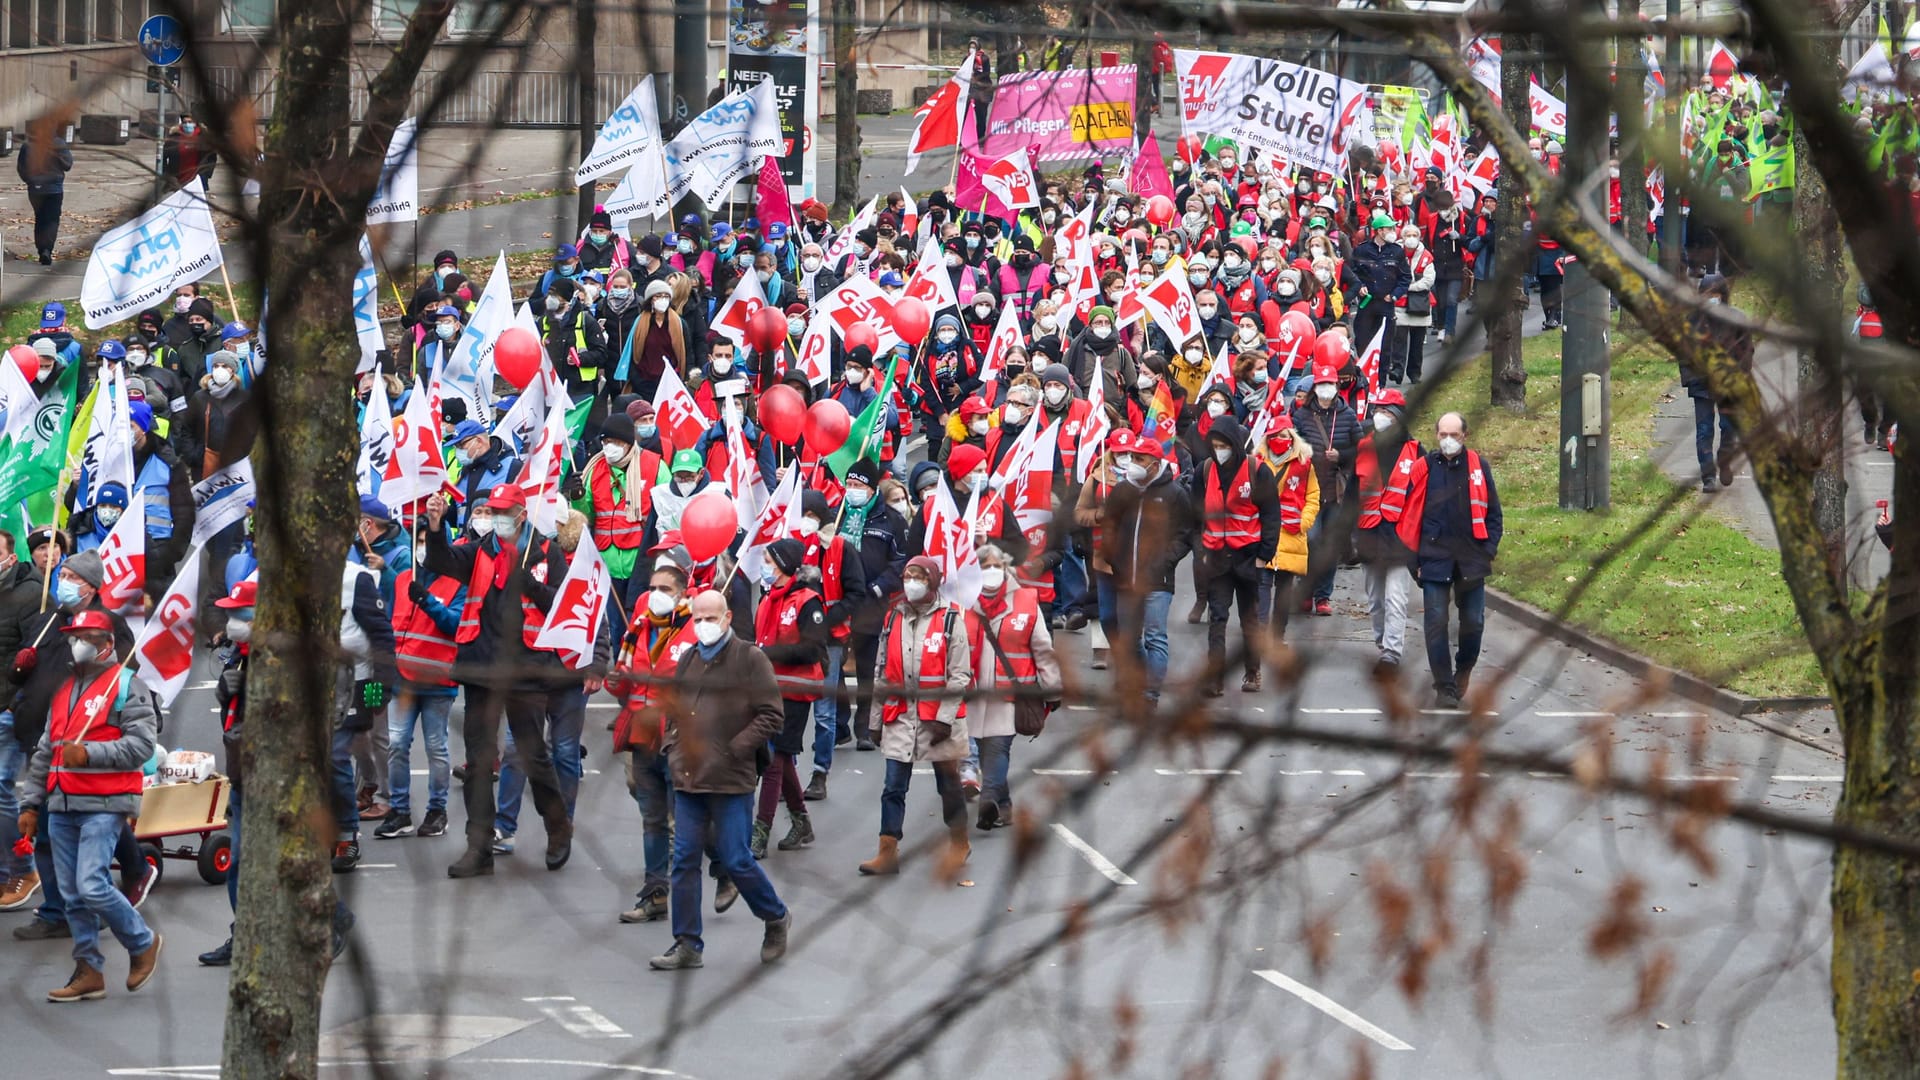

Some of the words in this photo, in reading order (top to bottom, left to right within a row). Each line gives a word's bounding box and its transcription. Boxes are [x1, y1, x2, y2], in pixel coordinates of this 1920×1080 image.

[1255, 59, 1336, 109] Volle
[1184, 100, 1218, 113] mund
[1529, 95, 1549, 116] W
[1551, 112, 1566, 126] S
[1014, 118, 1069, 136] Pflegen.
[1074, 110, 1131, 131] AACHEN
[1237, 94, 1325, 146] Stufe
[1231, 126, 1246, 137] der
[838, 288, 894, 337] GEW
[847, 472, 870, 483] POLIZEI
[159, 593, 195, 653] GE
[162, 766, 199, 779] Trad
